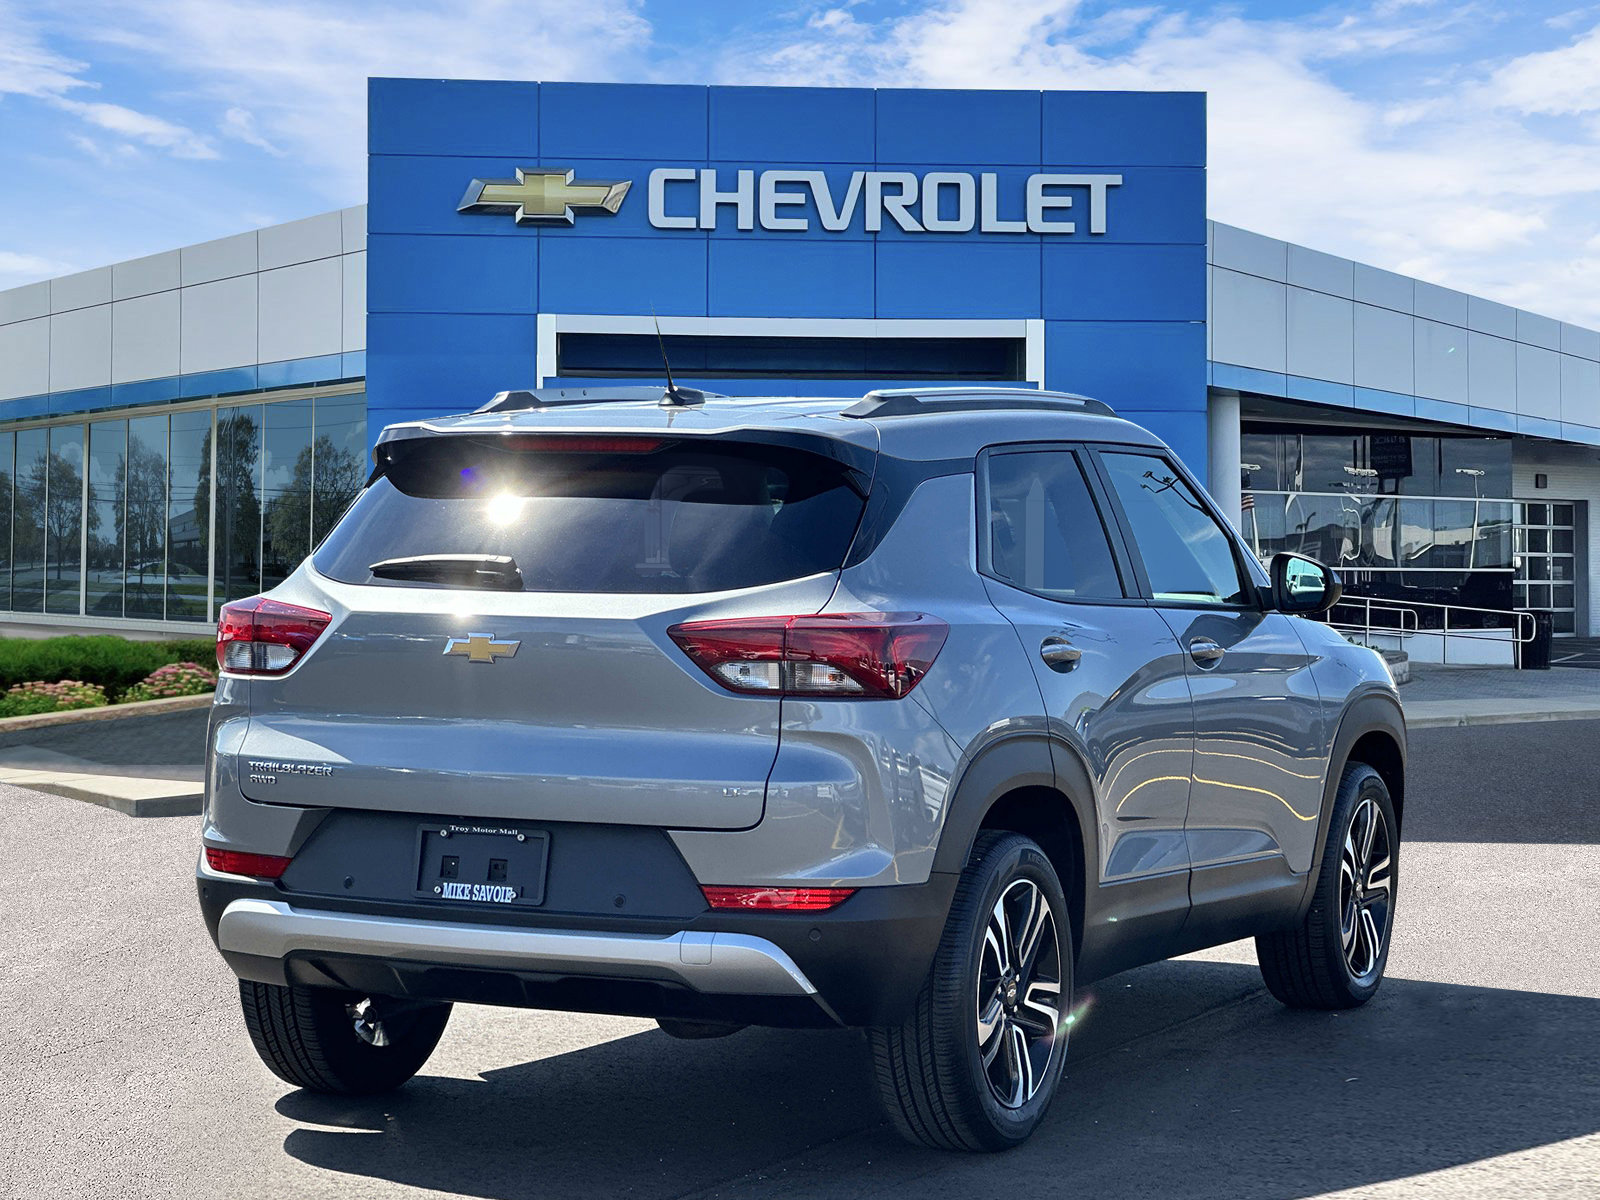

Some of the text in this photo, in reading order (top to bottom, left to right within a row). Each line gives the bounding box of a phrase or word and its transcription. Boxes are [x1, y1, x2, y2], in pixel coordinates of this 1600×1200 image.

[648, 167, 1123, 235] CHEVROLET
[248, 760, 334, 777] TRAILBLAZER
[449, 824, 470, 834] Troy
[472, 827, 497, 835] Motor
[441, 882, 471, 900] MIKE
